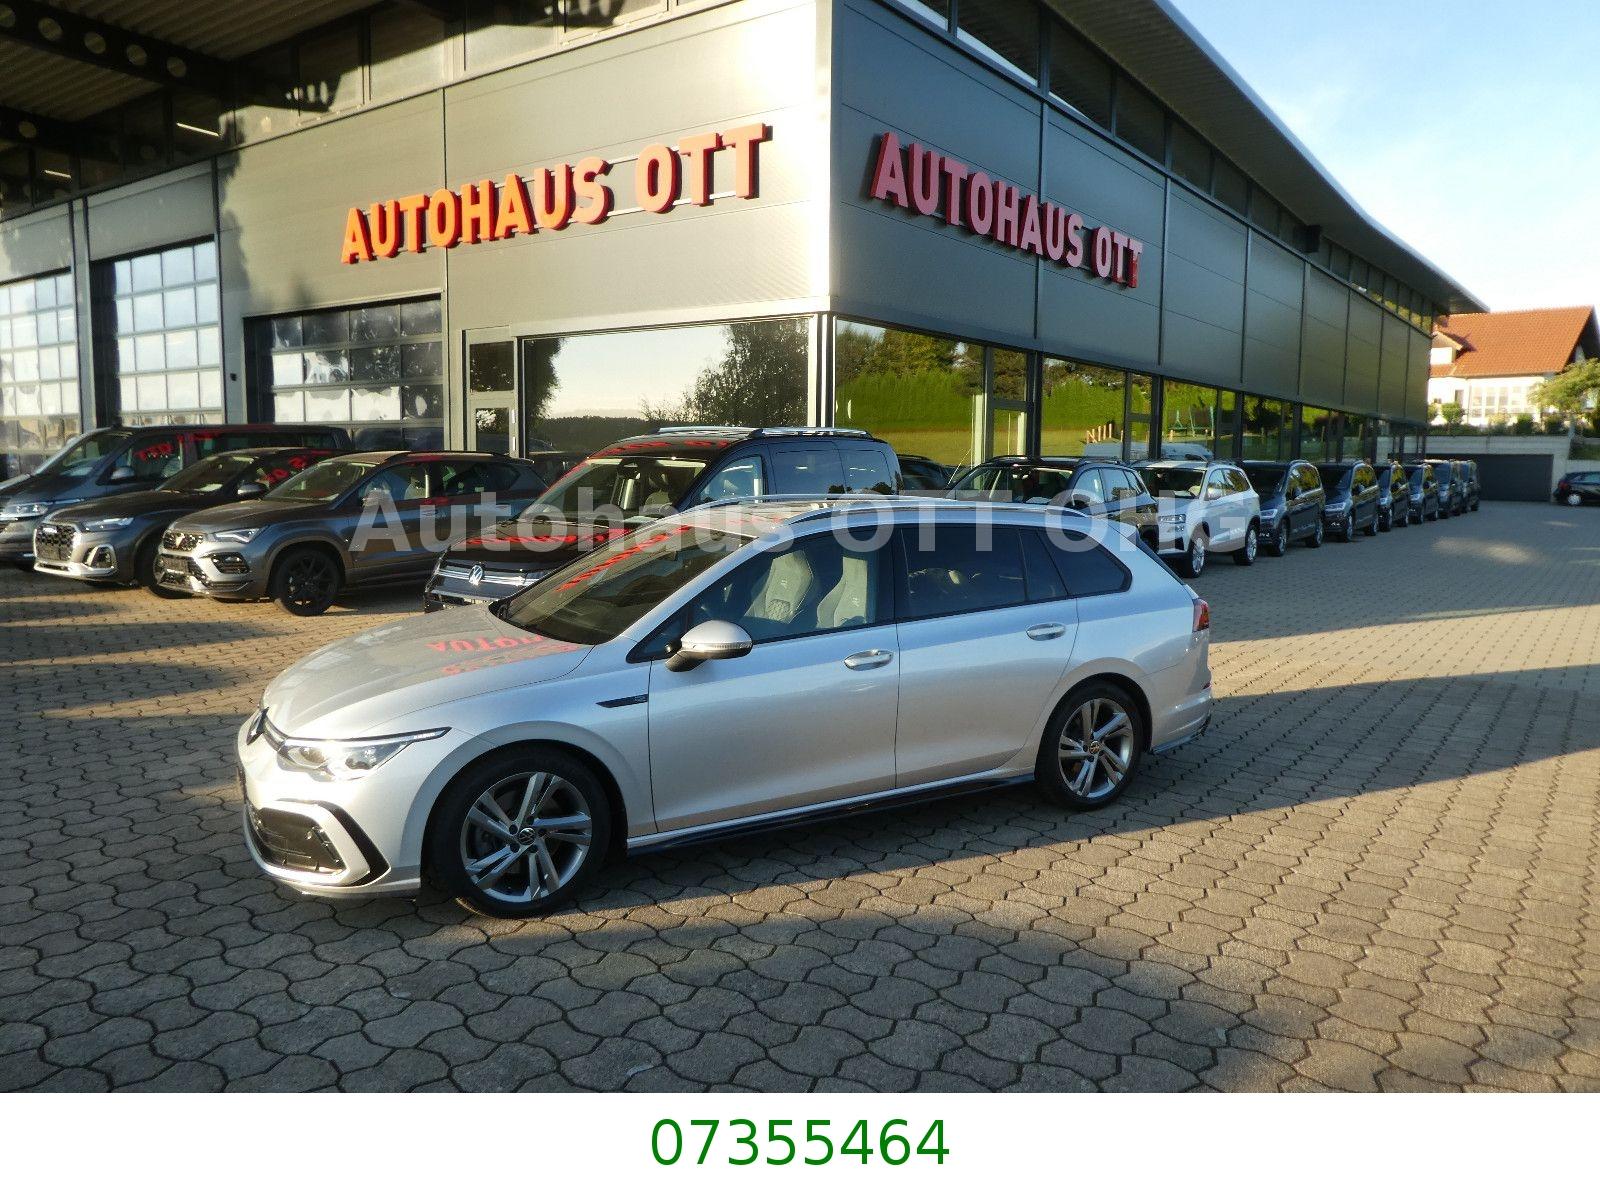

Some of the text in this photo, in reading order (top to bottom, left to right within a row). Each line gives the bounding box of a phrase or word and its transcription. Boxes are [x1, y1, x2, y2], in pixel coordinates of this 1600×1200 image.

[341, 122, 772, 264] AUTOHAUS OTT
[870, 131, 1143, 288] AUTOHAUS OTT
